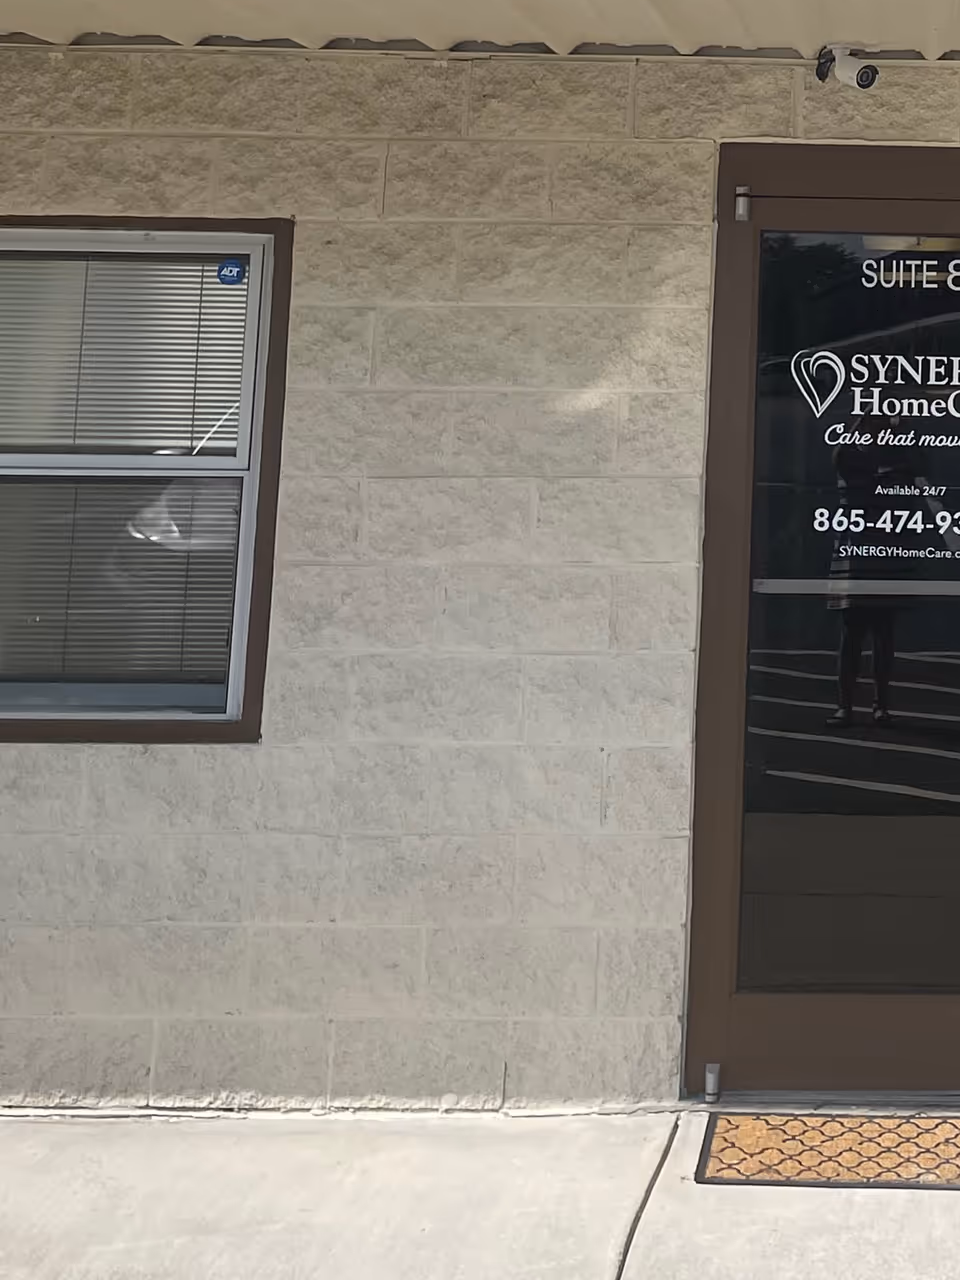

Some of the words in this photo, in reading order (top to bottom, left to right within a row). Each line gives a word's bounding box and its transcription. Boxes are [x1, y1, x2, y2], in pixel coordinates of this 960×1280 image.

[220, 266, 240, 277] ADT
[861, 259, 938, 289] SUITE
[824, 422, 874, 446] Care
[876, 428, 917, 446] that
[874, 484, 921, 496] Available
[922, 485, 947, 497] 24/7
